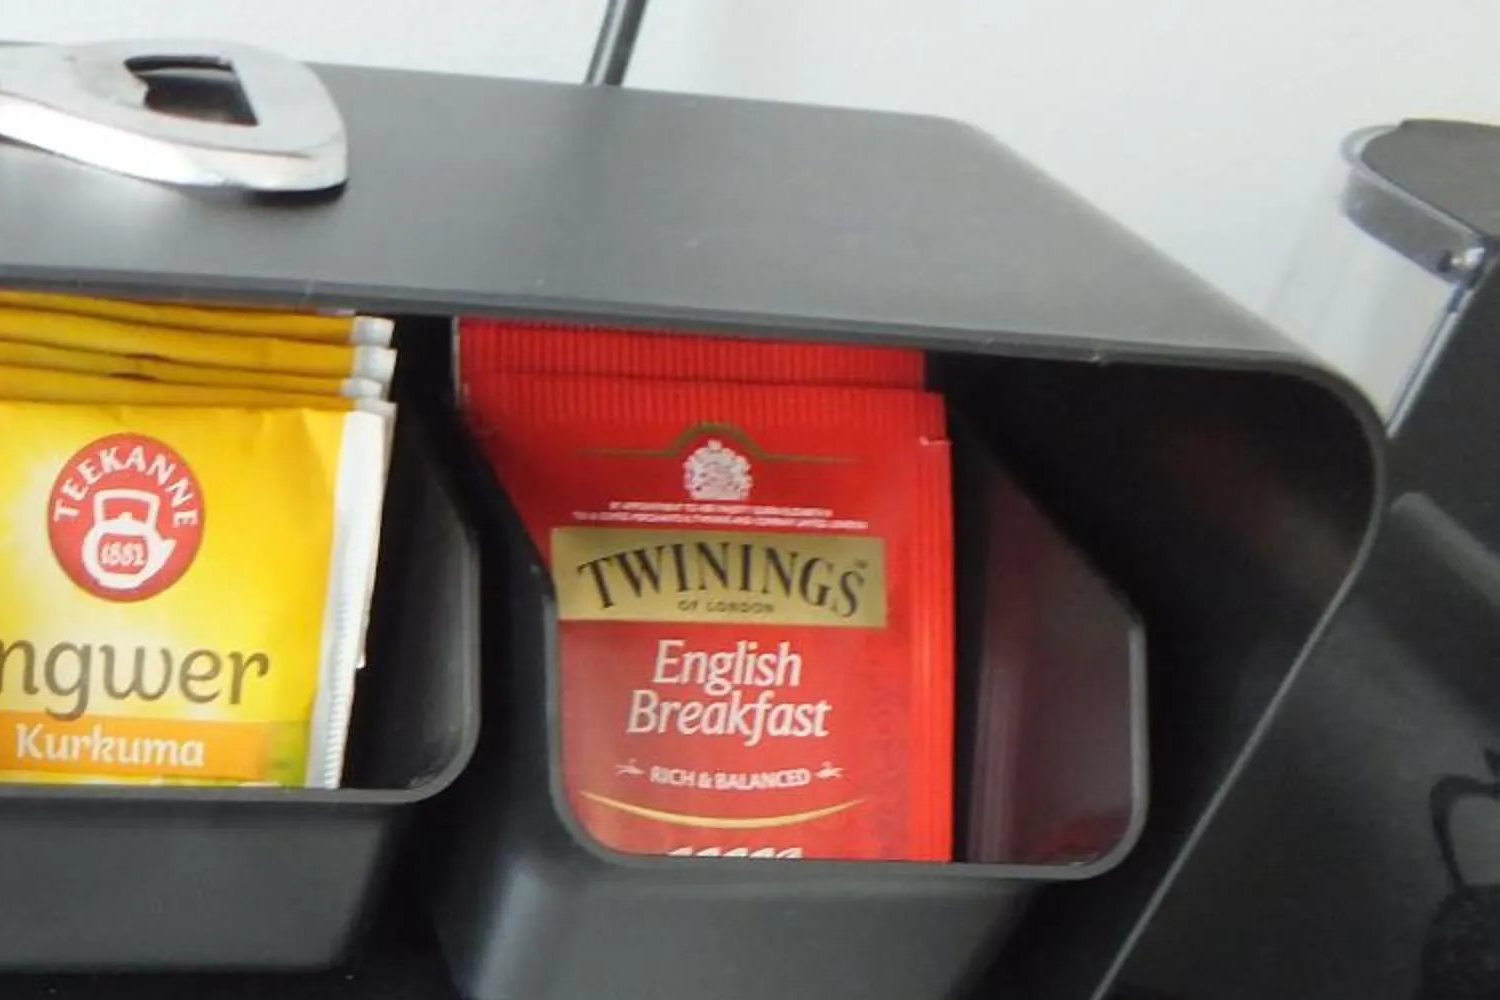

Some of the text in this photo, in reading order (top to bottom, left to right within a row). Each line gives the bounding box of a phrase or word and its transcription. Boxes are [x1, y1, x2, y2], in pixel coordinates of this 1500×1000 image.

[53, 446, 199, 529] TEEKANNE
[577, 541, 866, 619] TWININGS
[677, 599, 775, 614] OF LONDON
[652, 639, 802, 697] English
[15, 722, 205, 766] Kurkuma
[626, 690, 832, 746] Breakfast
[650, 765, 696, 787] RICH
[714, 768, 812, 790] BALANCED
